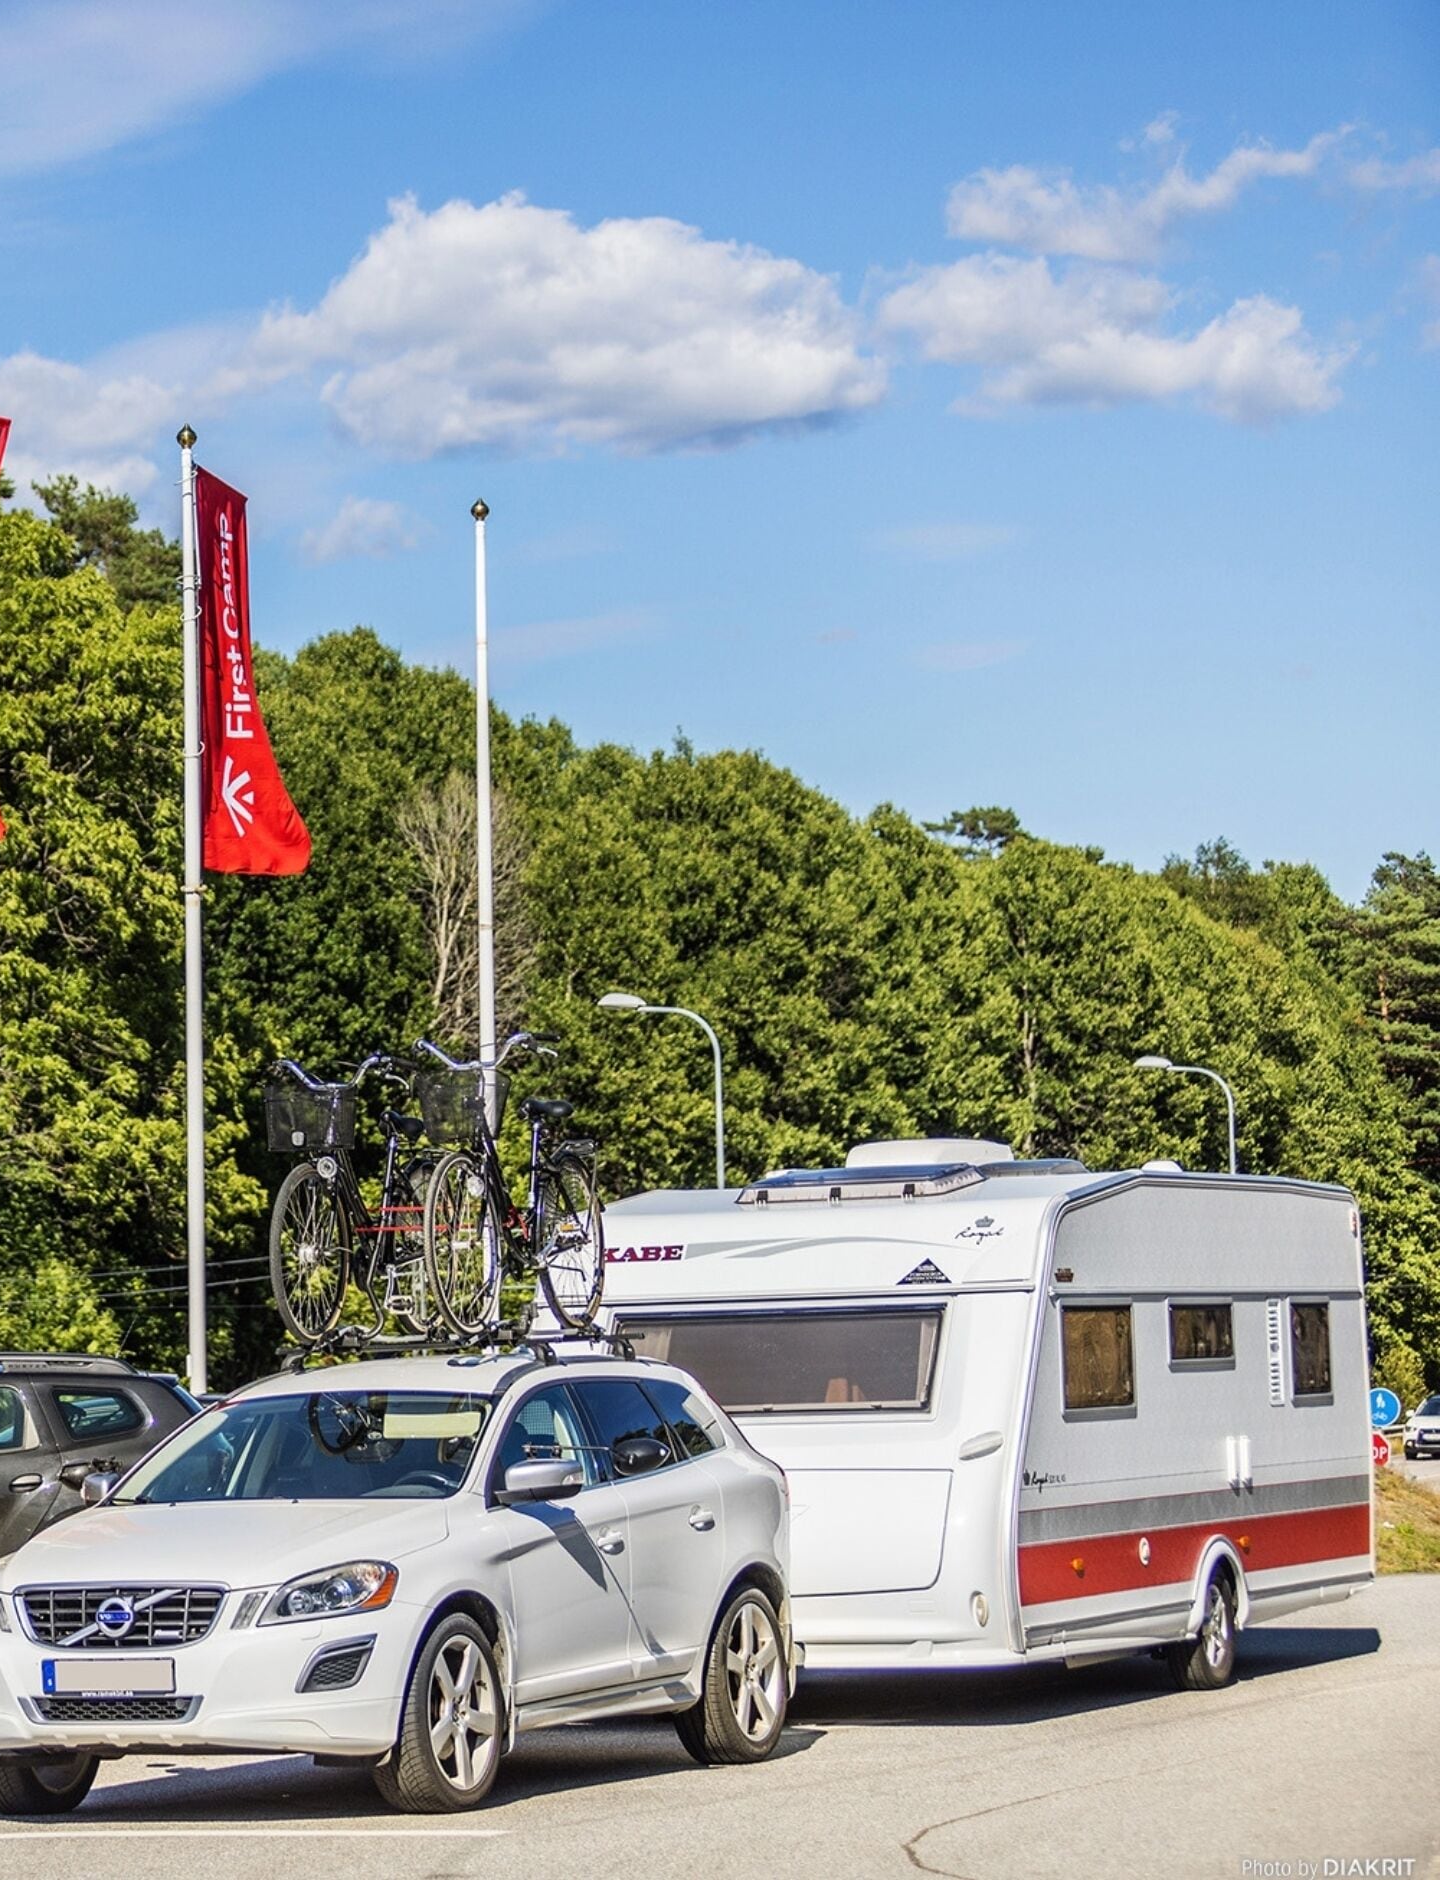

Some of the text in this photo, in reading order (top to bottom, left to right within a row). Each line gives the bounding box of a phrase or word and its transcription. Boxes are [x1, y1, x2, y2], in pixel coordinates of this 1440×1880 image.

[225, 645, 254, 738] First
[603, 1245, 684, 1263] KABE
[98, 1612, 130, 1621] VOLVO
